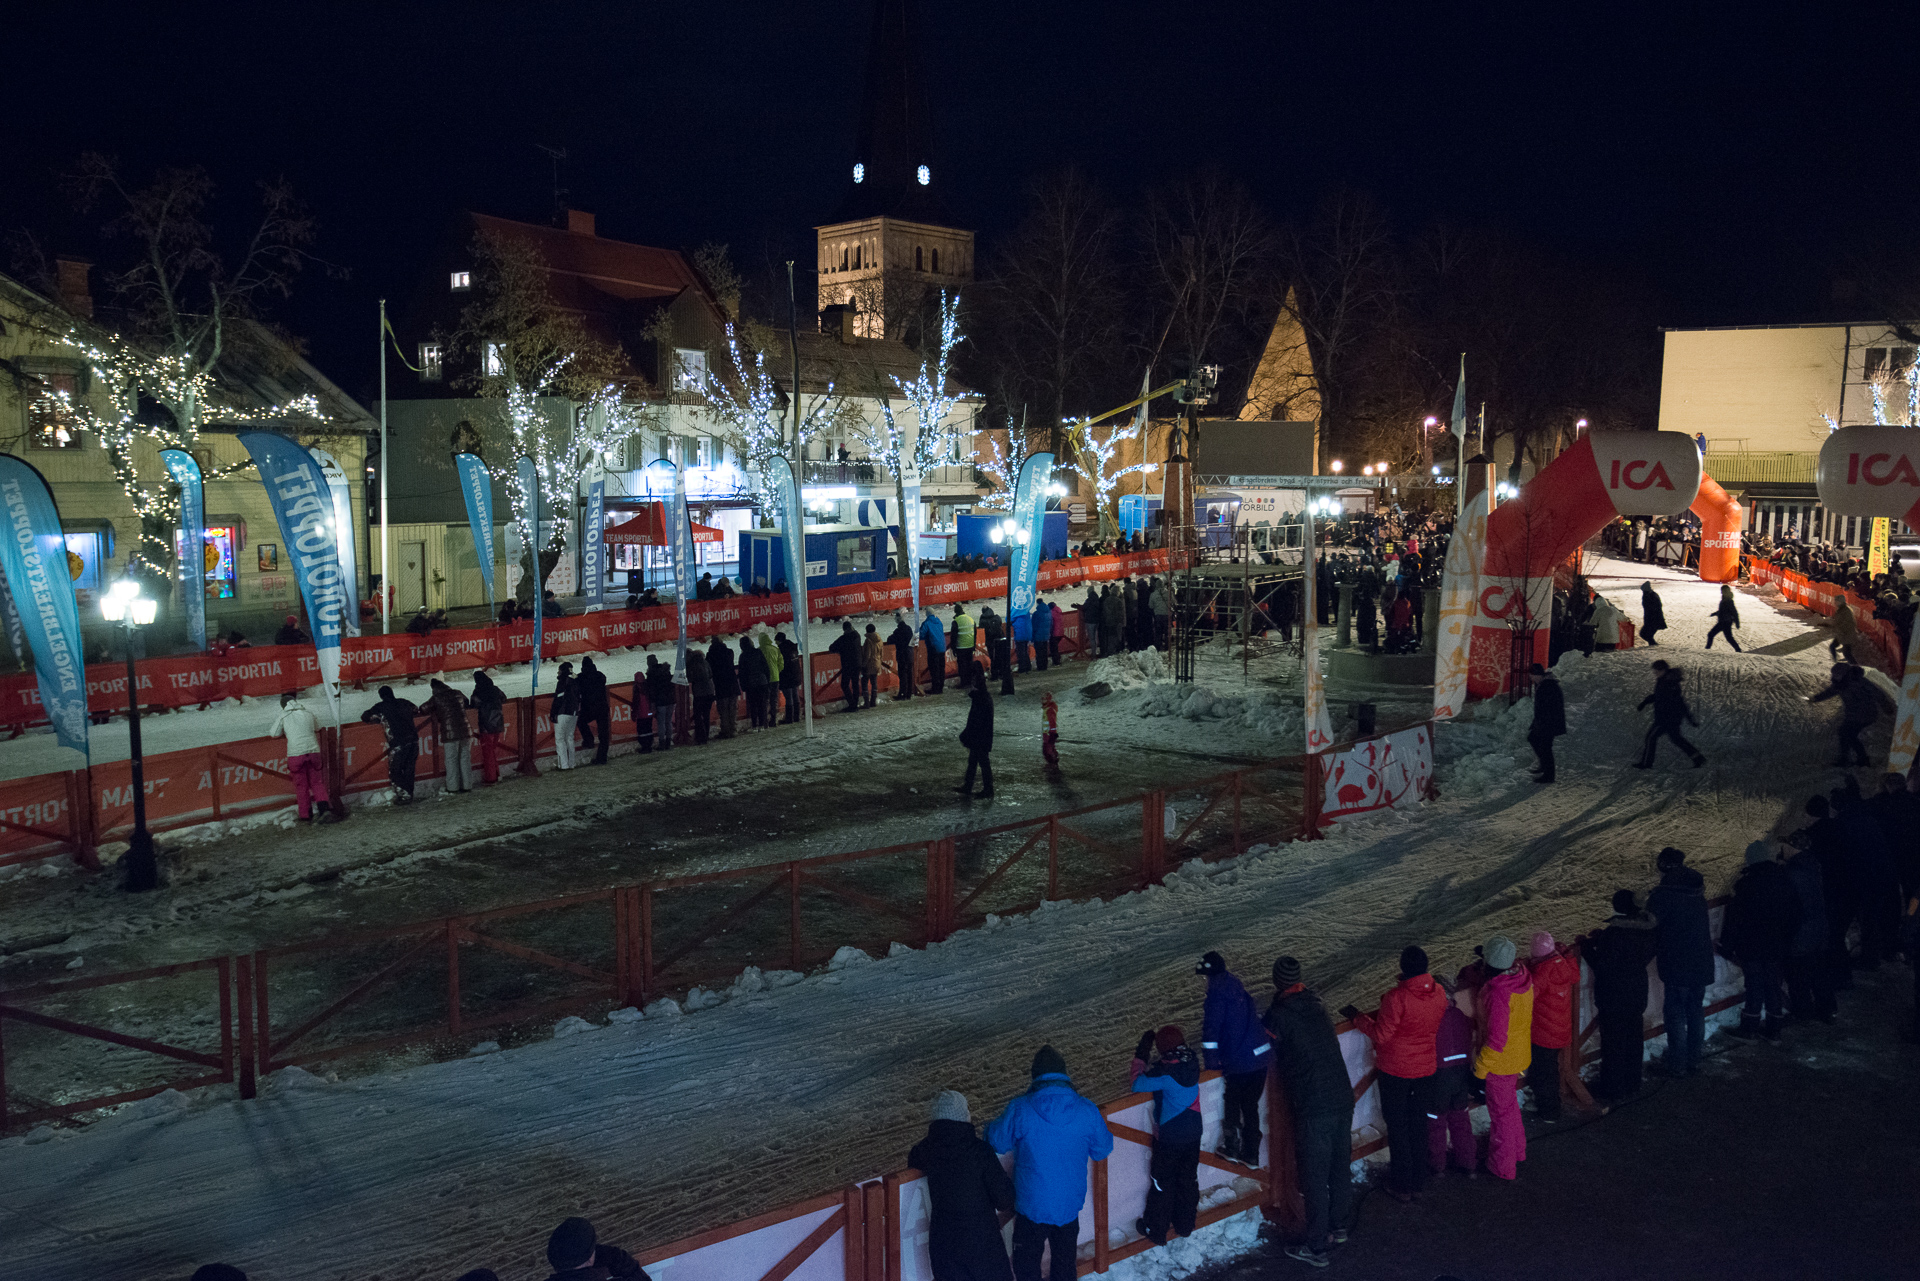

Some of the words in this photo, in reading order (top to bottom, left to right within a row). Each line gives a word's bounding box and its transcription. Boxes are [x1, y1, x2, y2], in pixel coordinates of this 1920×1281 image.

[1610, 460, 1676, 491] ICA
[1847, 453, 1920, 487] ICA
[1240, 503, 1275, 511] TORBILD
[606, 534, 624, 542] TEAM
[624, 534, 653, 543] SPORTIA
[1717, 531, 1741, 540] TEAM
[1704, 539, 1741, 549] SPORTIA
[1055, 569, 1070, 579] TEAM
[925, 584, 943, 595] TEAM
[943, 581, 969, 593] SPORTIA
[974, 578, 990, 589] TEAM
[990, 576, 1008, 588] SPORT
[814, 596, 835, 609] TEAM
[836, 592, 866, 606] SPORTIA
[871, 590, 889, 601] TEAM
[1479, 585, 1534, 621] CA
[702, 608, 740, 623] SPORTIA
[749, 604, 772, 617] TEAM
[773, 602, 793, 615] SPOR
[600, 623, 627, 637] TEAM
[629, 617, 667, 634] SPORTIA
[509, 632, 535, 649] TEA
[544, 627, 589, 645] SPORTIA
[409, 643, 443, 660] TEAM
[446, 637, 496, 656] SPORTIA
[339, 647, 394, 667] SPORTIA
[168, 670, 213, 689] TEAM
[217, 660, 283, 683] SPORTIA
[18, 687, 41, 706] TE
